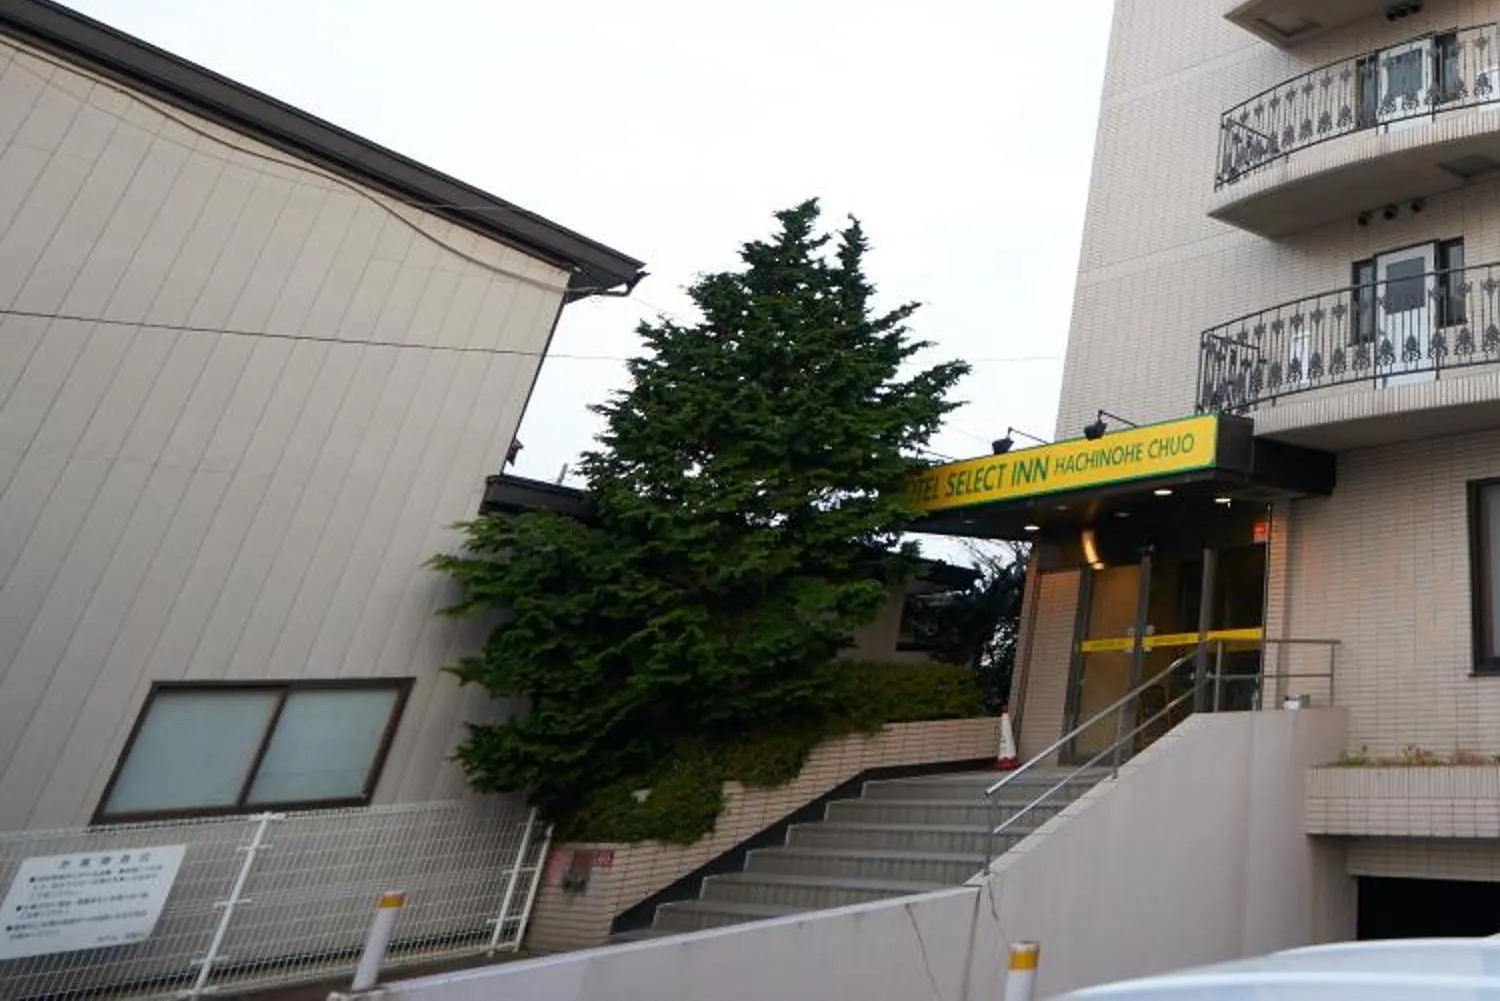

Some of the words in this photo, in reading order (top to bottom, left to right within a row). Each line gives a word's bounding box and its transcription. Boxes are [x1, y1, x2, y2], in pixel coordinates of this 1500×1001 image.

[904, 476, 939, 504] OTEL
[945, 462, 1008, 496] SELECT
[1012, 454, 1049, 488] INN
[1054, 442, 1145, 476] HACHINOHE
[1147, 433, 1195, 459] CHUO
